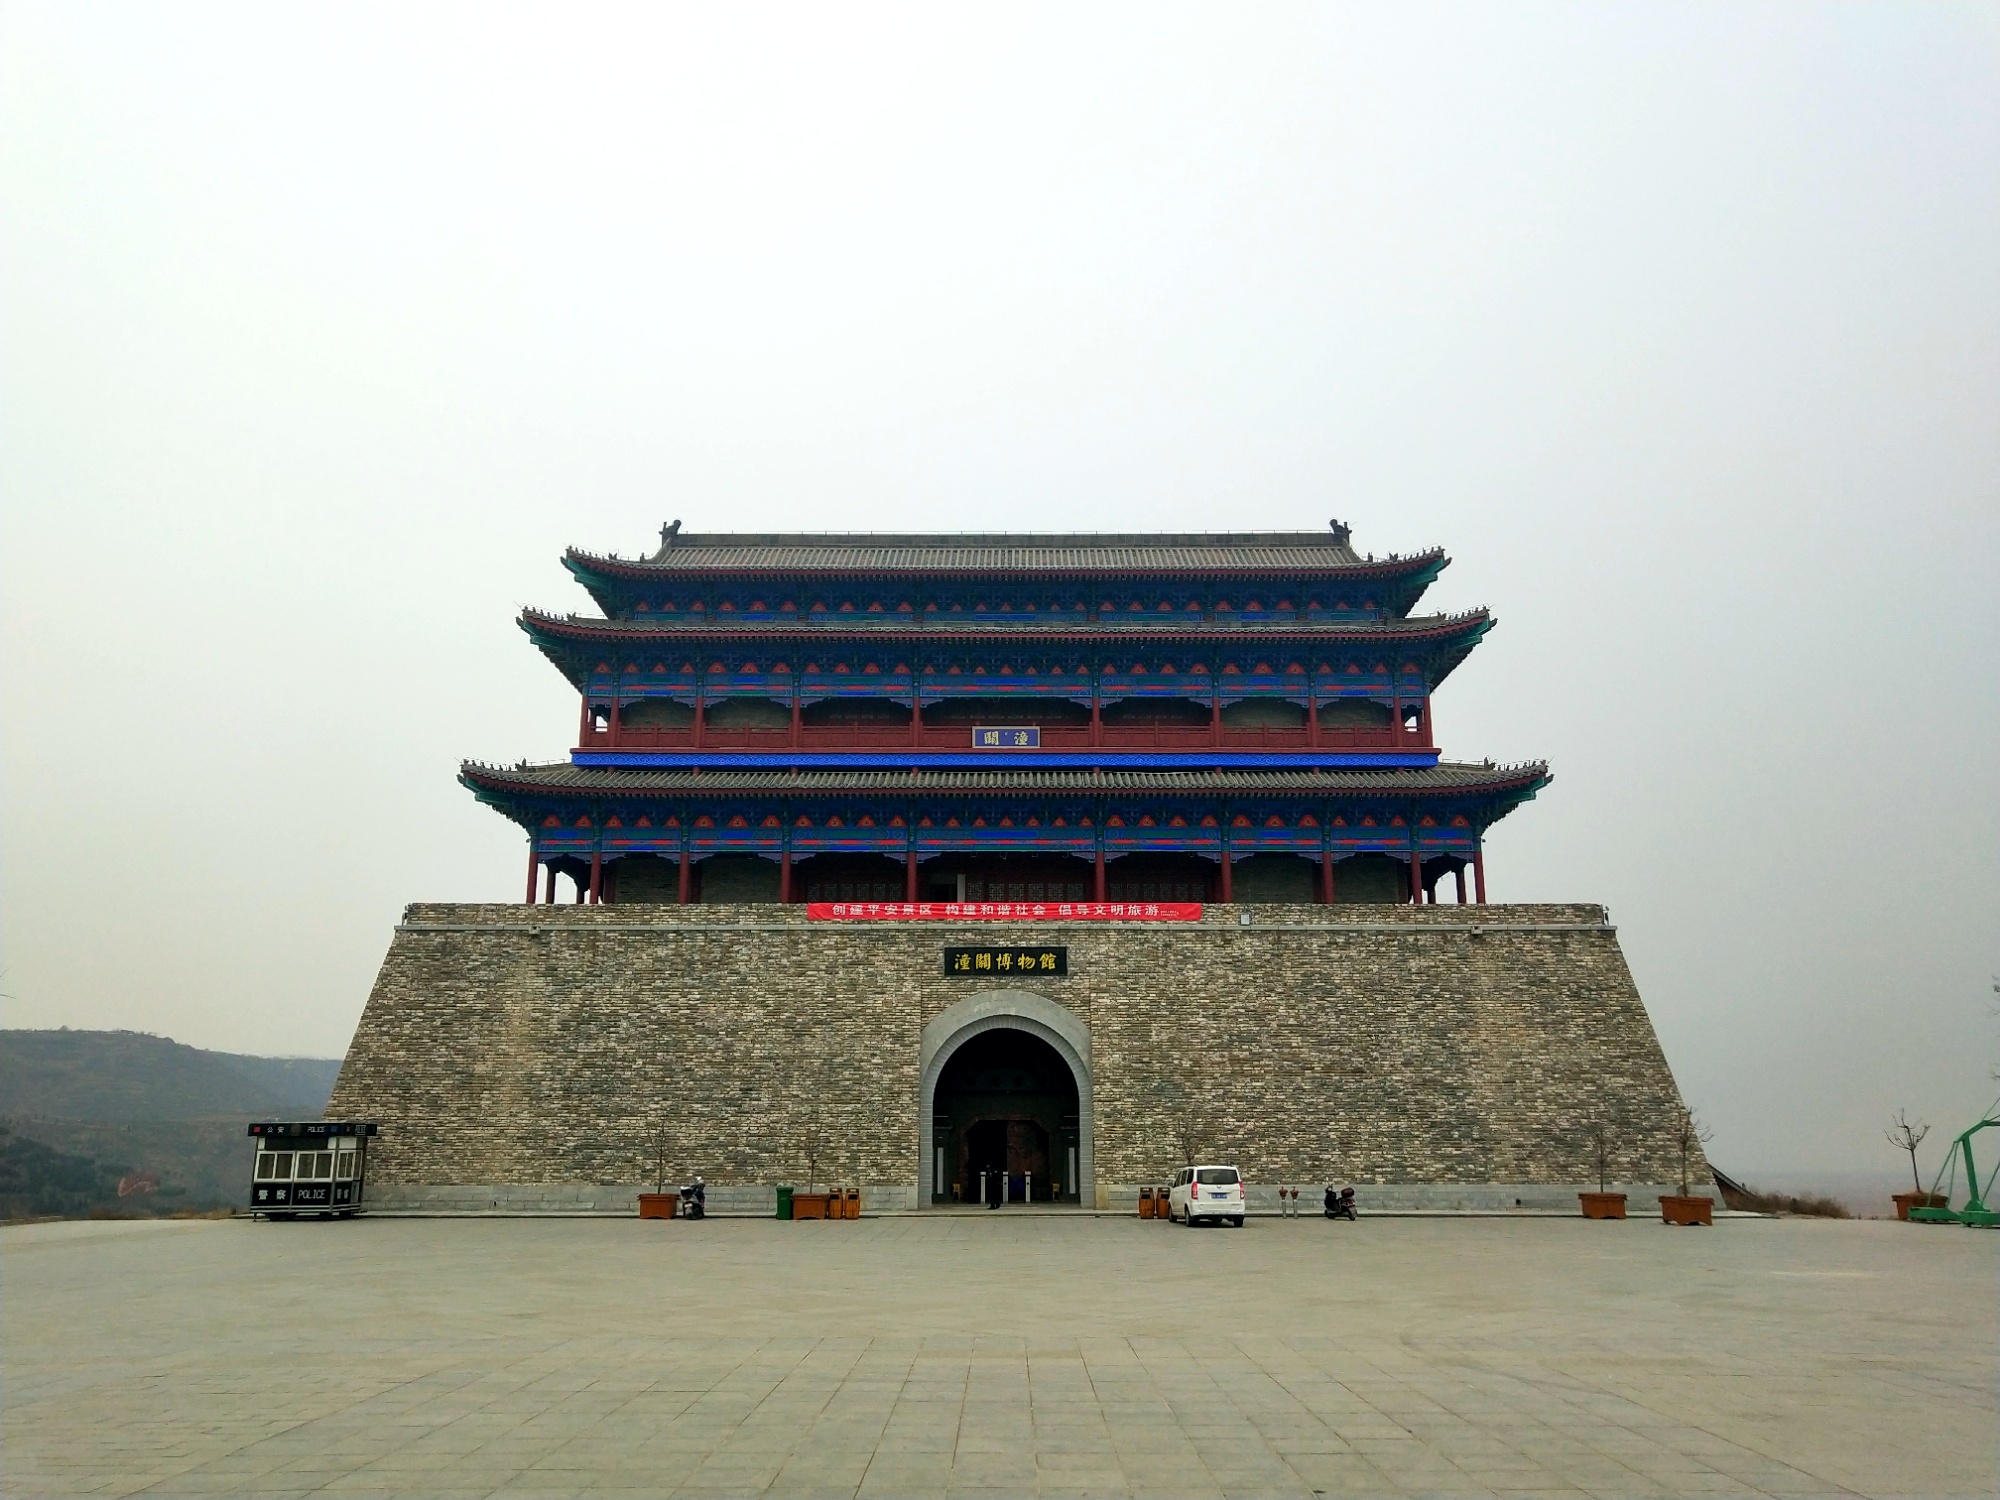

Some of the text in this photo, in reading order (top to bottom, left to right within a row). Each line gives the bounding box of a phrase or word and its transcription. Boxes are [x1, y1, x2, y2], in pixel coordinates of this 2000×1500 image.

[832, 904, 1160, 917] 创建平安景区 构建和谐社会 倡导文明旅游
[954, 952, 1057, 971] 潼關博物館
[258, 1189, 287, 1200] 警察
[298, 1189, 326, 1199] POLICE
